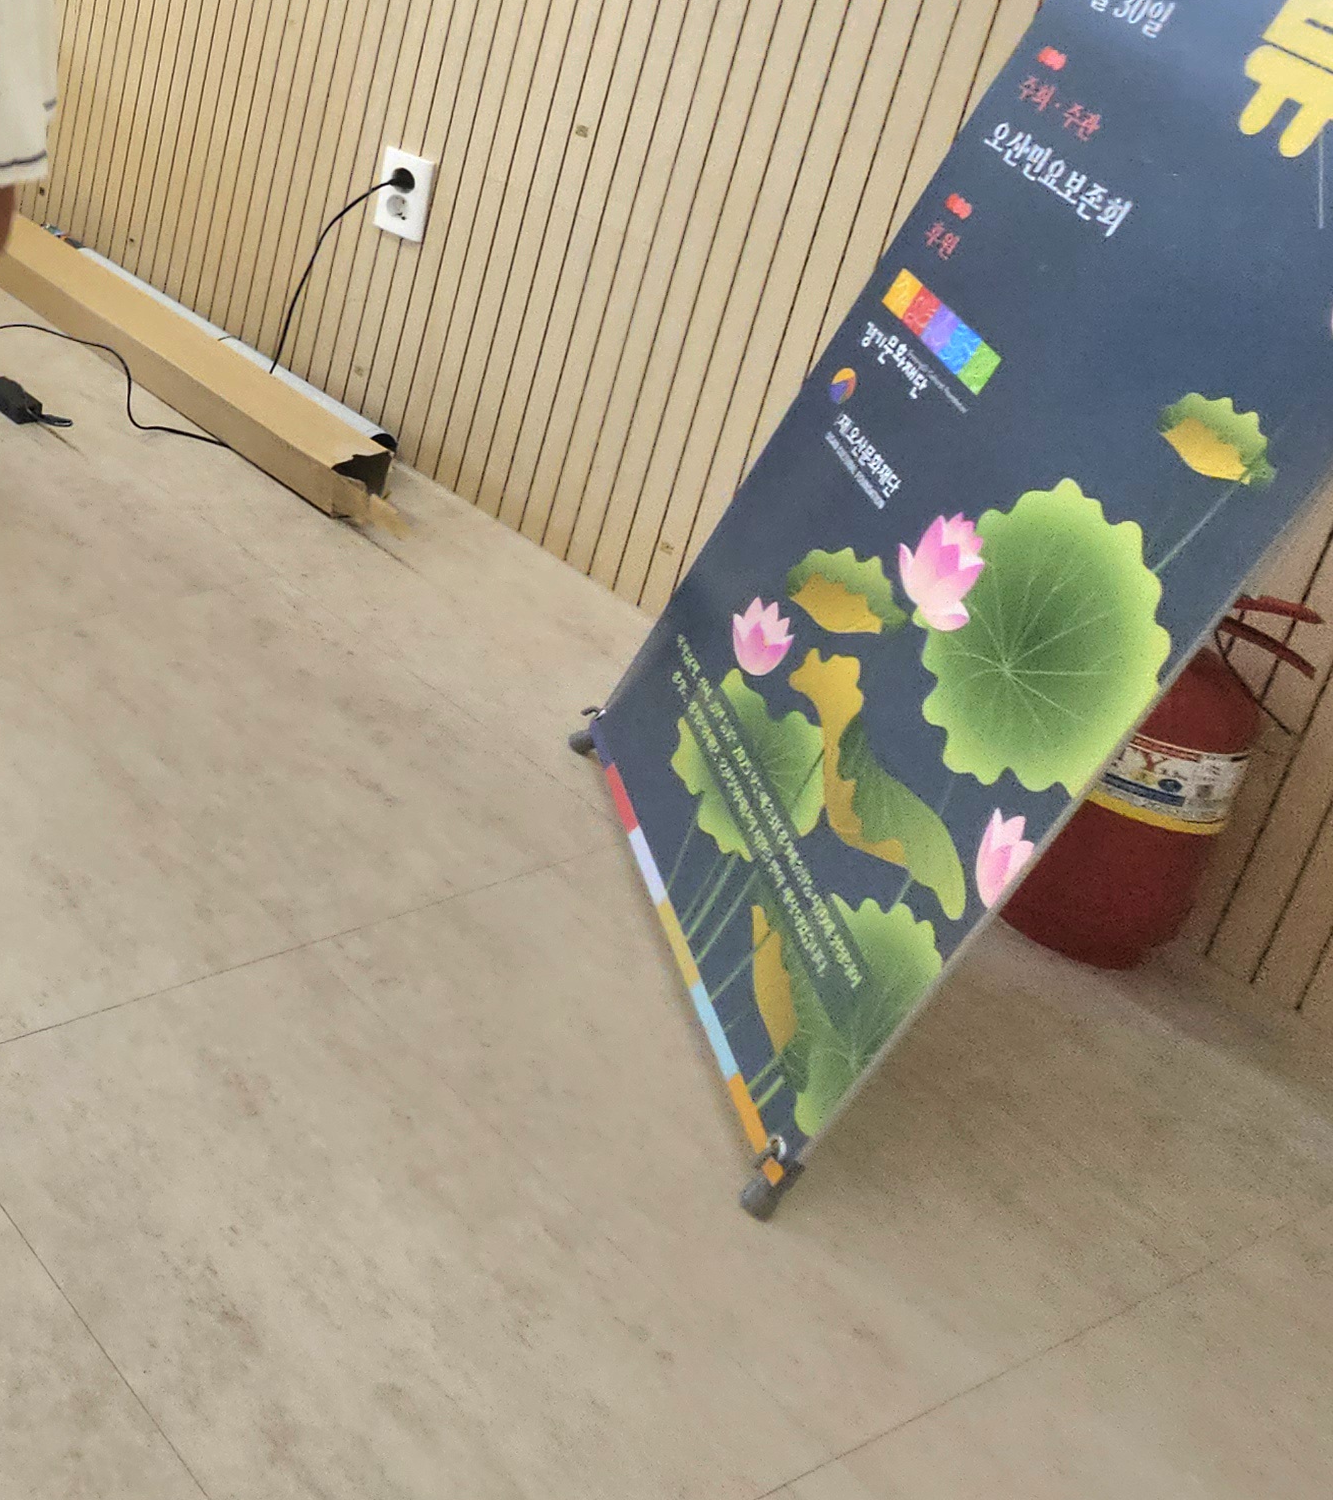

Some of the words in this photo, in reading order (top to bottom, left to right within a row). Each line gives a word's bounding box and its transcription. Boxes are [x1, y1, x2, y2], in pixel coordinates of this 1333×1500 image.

[984, 122, 1132, 237] 오산민요보존회
[925, 222, 961, 260] 후원
[860, 321, 929, 400] 경기문화재단
